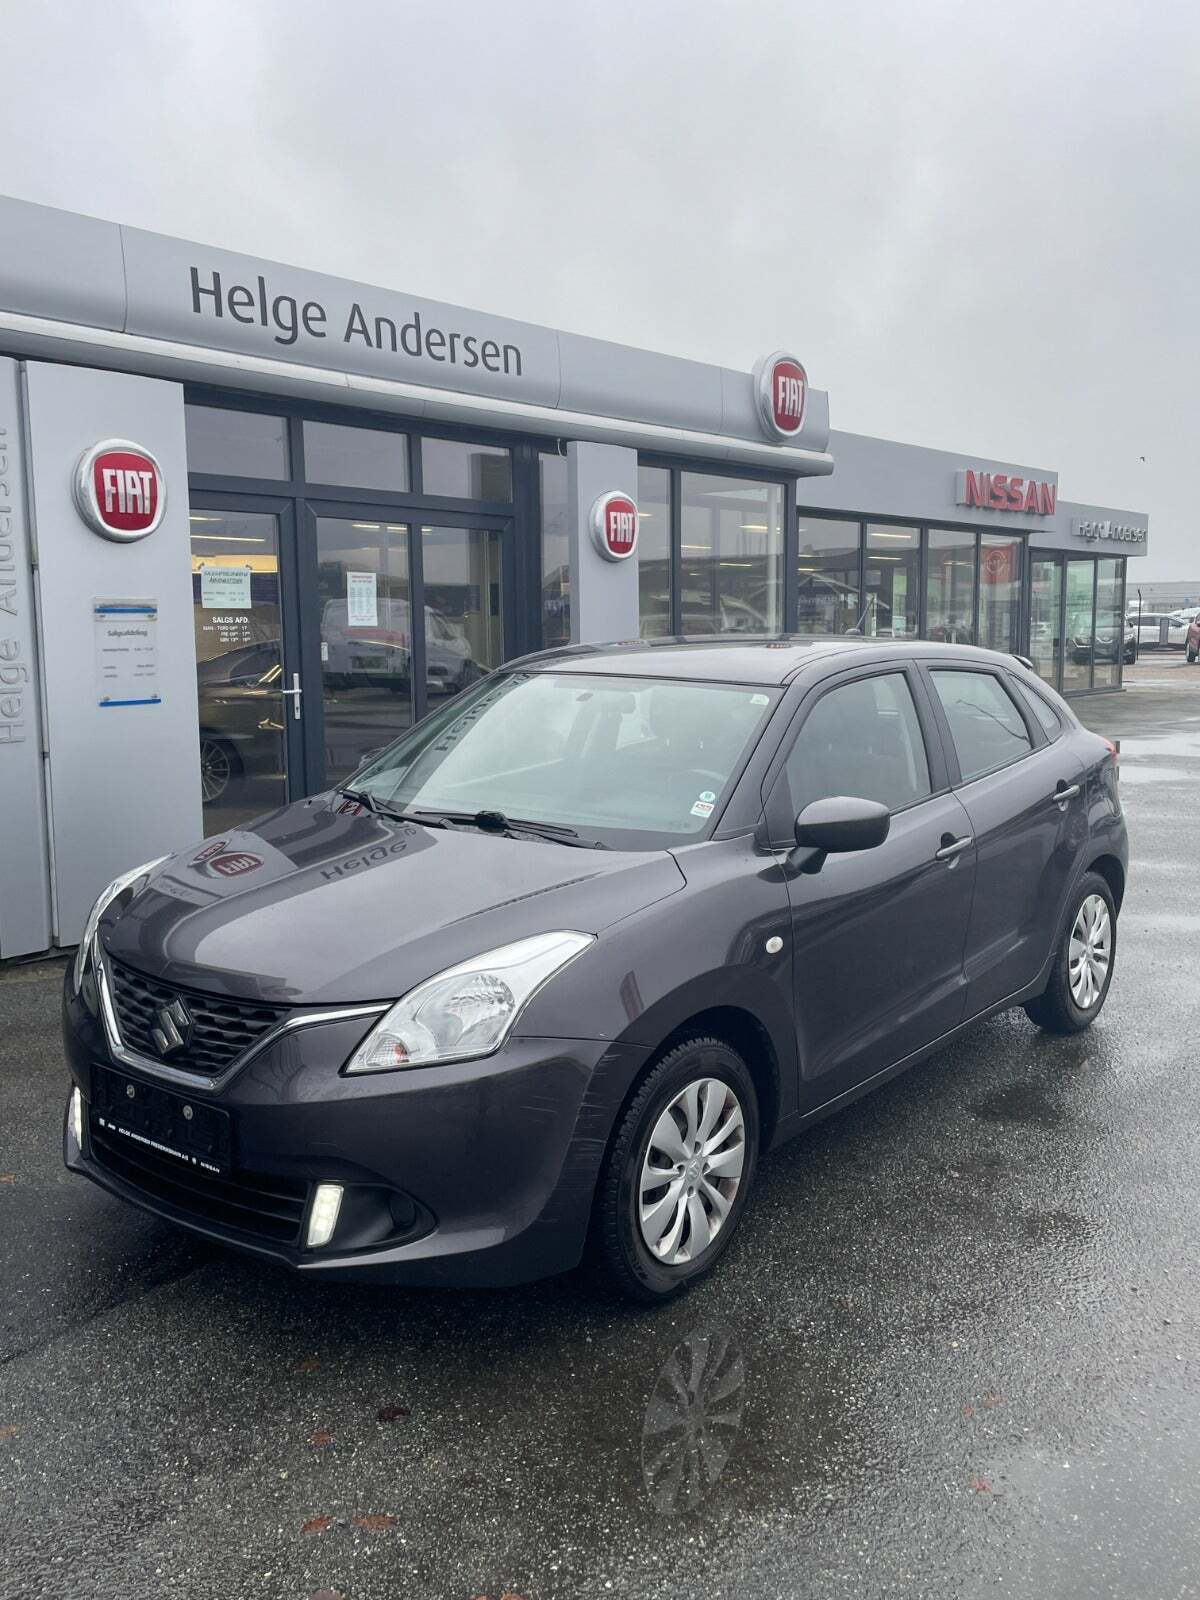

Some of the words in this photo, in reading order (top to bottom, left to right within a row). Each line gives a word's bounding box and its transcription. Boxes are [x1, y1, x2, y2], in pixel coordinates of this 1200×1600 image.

[190, 266, 327, 345] Helge
[343, 303, 522, 376] Andersen
[776, 375, 804, 418] FIAT
[102, 468, 152, 514] FIAT
[965, 469, 1056, 516] NISSAN
[609, 511, 634, 543] FIAT
